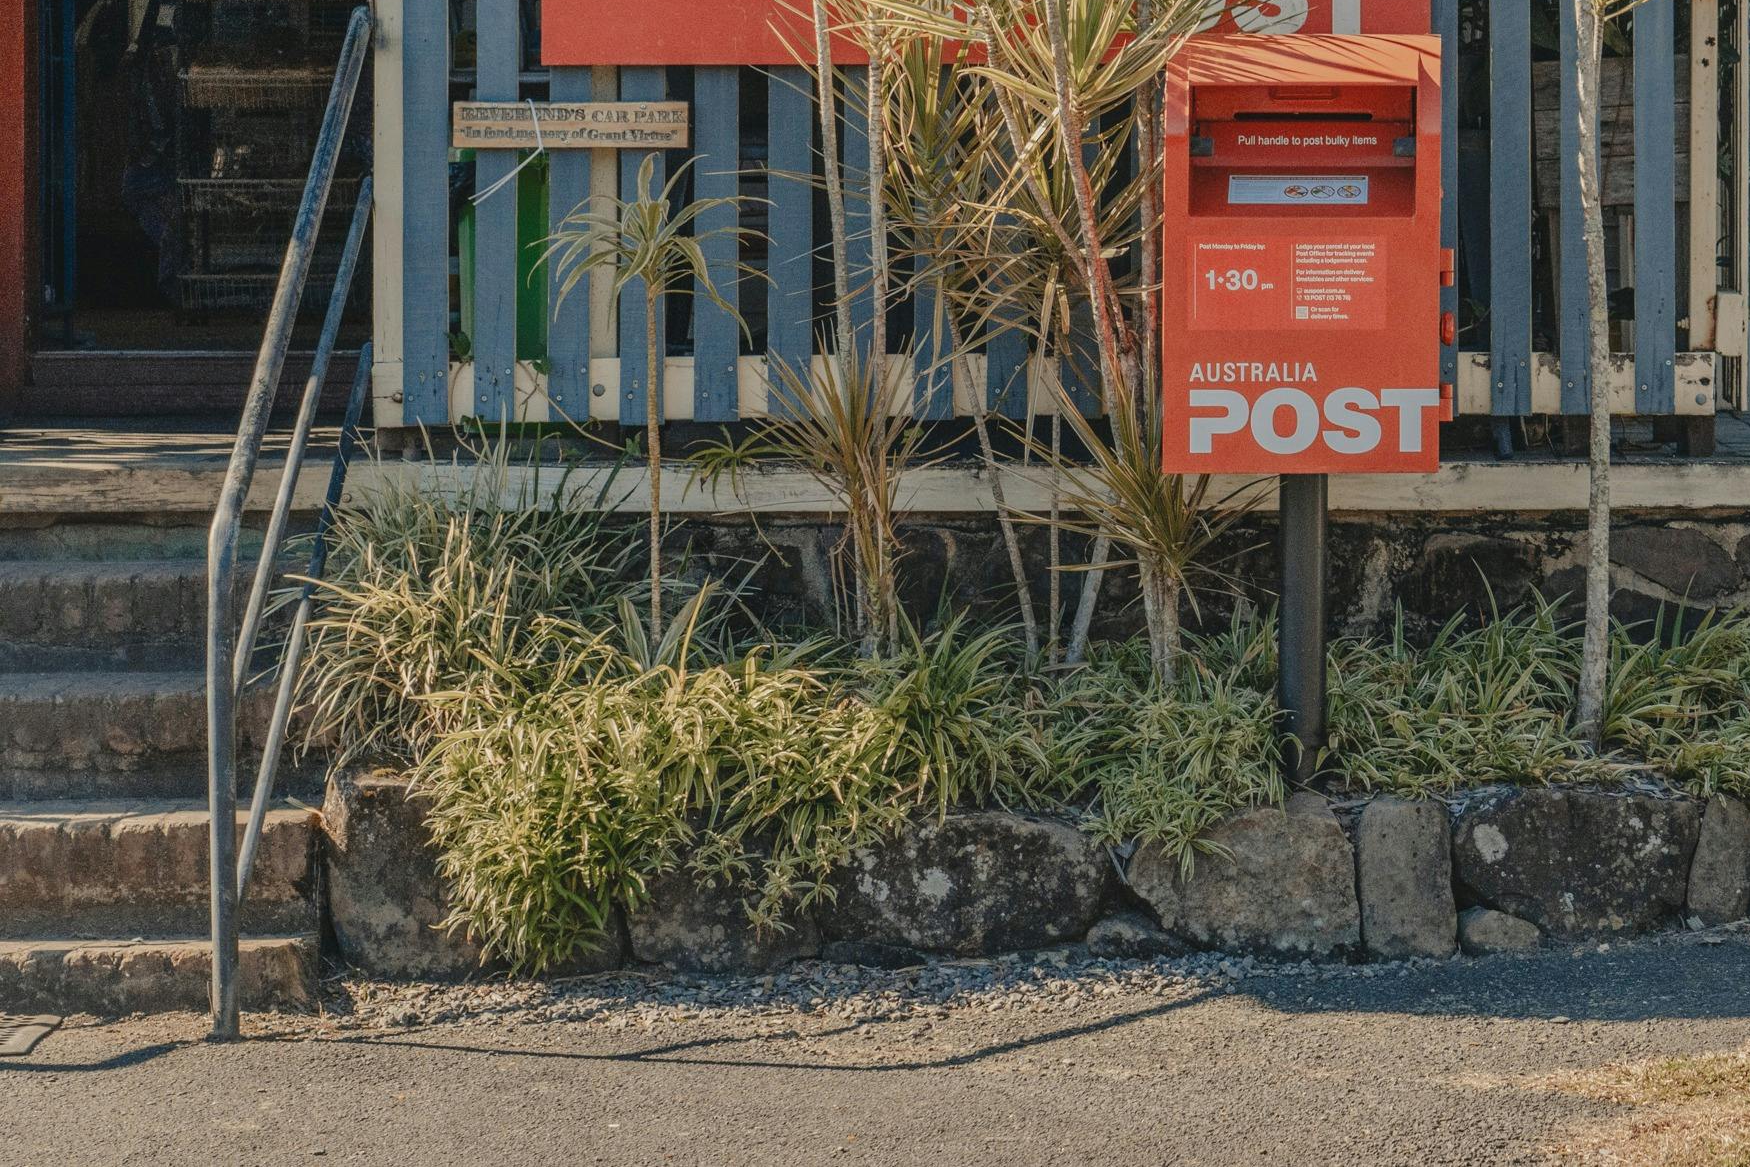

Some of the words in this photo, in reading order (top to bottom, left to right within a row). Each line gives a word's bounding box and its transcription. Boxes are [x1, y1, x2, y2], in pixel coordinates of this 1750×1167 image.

[461, 107, 586, 122] REVEREND'S
[591, 110, 630, 123] CAR
[634, 110, 687, 123] PARK
[484, 127, 513, 139] fond
[515, 129, 570, 141] memory
[571, 128, 586, 139] of
[587, 129, 626, 140] Grant
[1238, 135, 1256, 145] Pull
[1258, 135, 1289, 146] handle
[1292, 136, 1301, 146] to
[1303, 136, 1323, 147] post
[1326, 135, 1350, 147] bulky
[1352, 135, 1377, 145] items
[1240, 243, 1257, 251] Friday
[1261, 282, 1274, 291] pm
[1189, 362, 1318, 382] AUSTRALIA
[1189, 387, 1440, 454] POST
